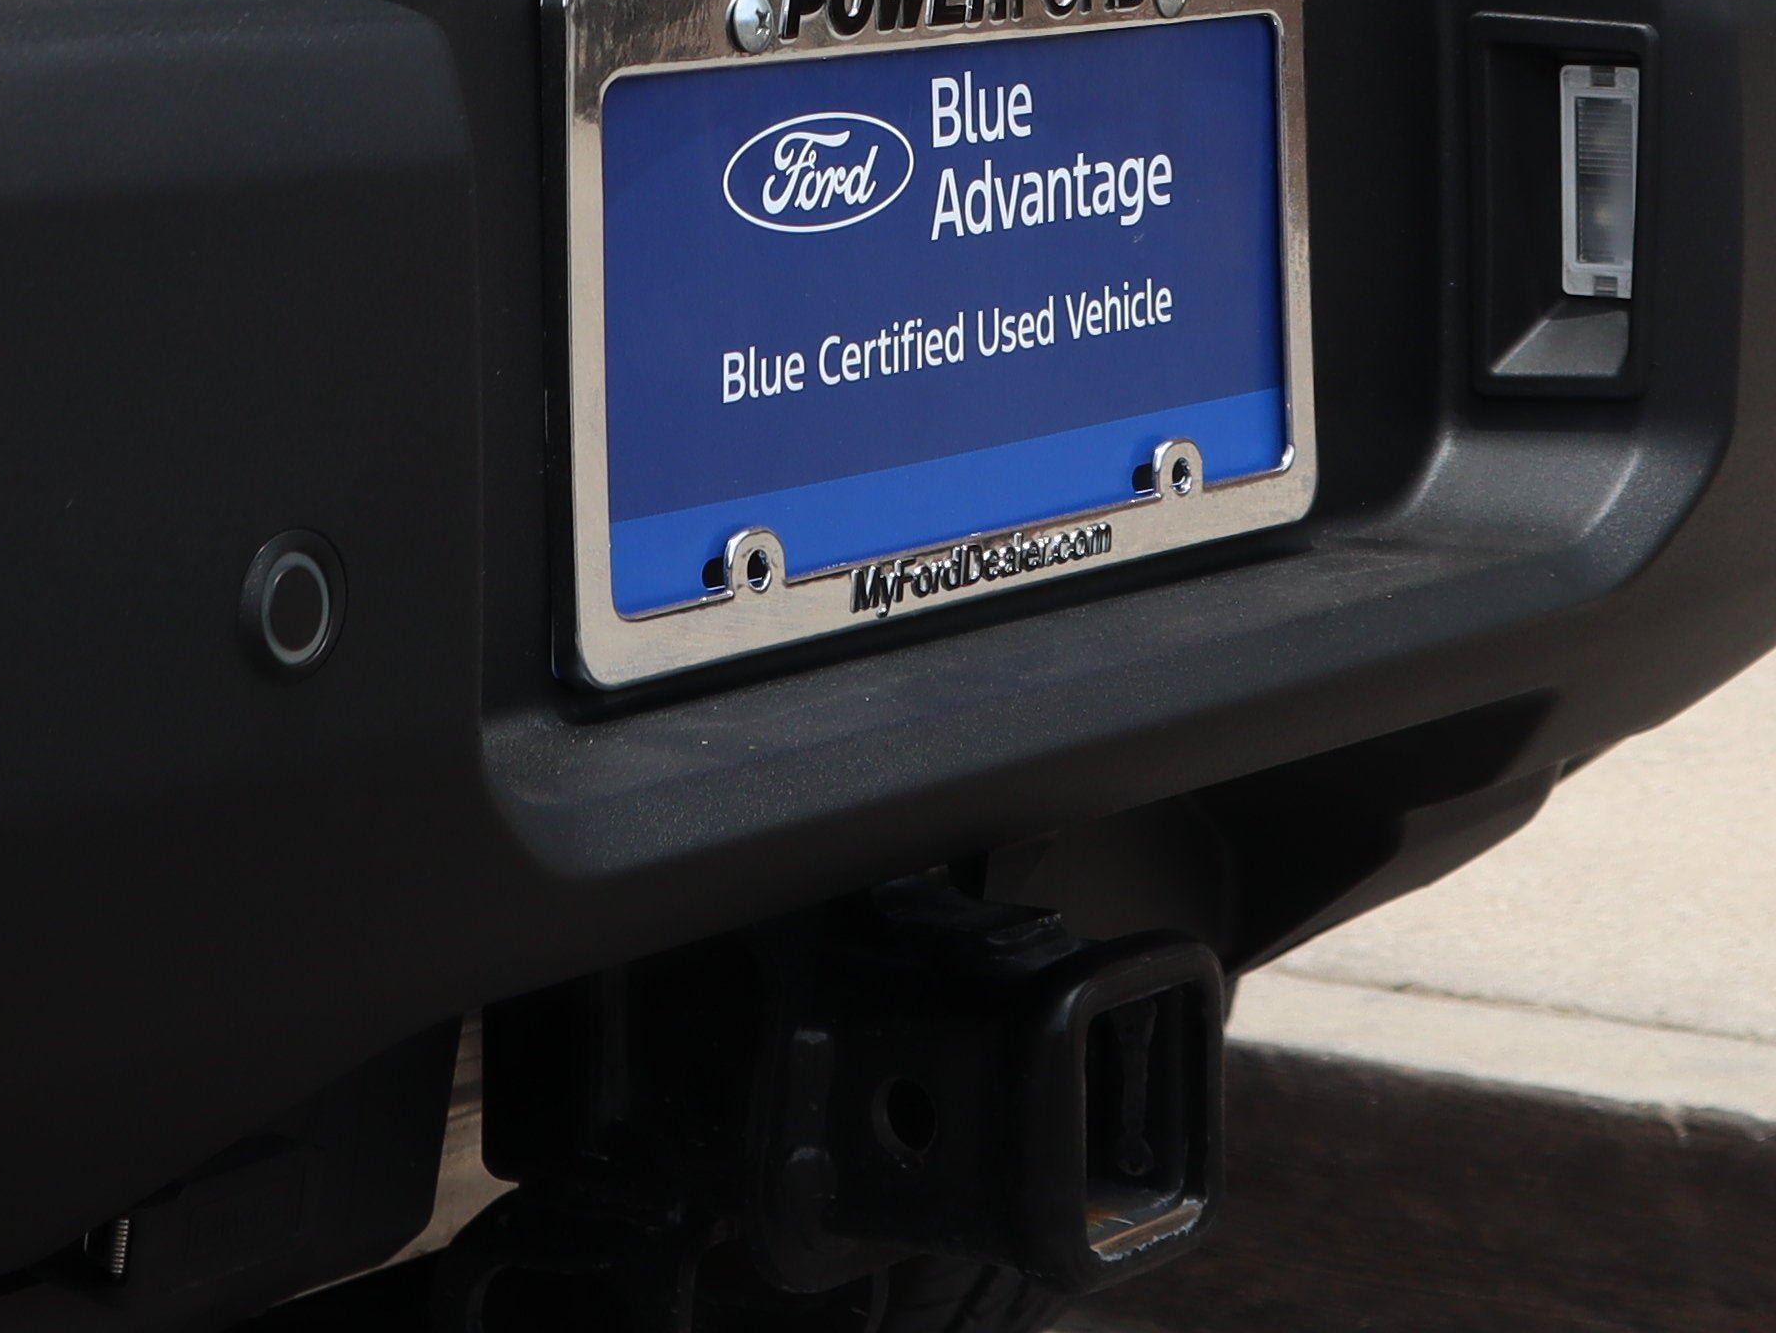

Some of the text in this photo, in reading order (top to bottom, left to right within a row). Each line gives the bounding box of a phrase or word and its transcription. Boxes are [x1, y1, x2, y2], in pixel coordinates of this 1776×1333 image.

[930, 70, 1034, 149] Blue
[762, 129, 878, 213] Ford
[930, 152, 1174, 242] Advantage
[721, 277, 1174, 405] Blue Certified Used Vehicle
[849, 522, 1113, 618] MyFordDealer.com
